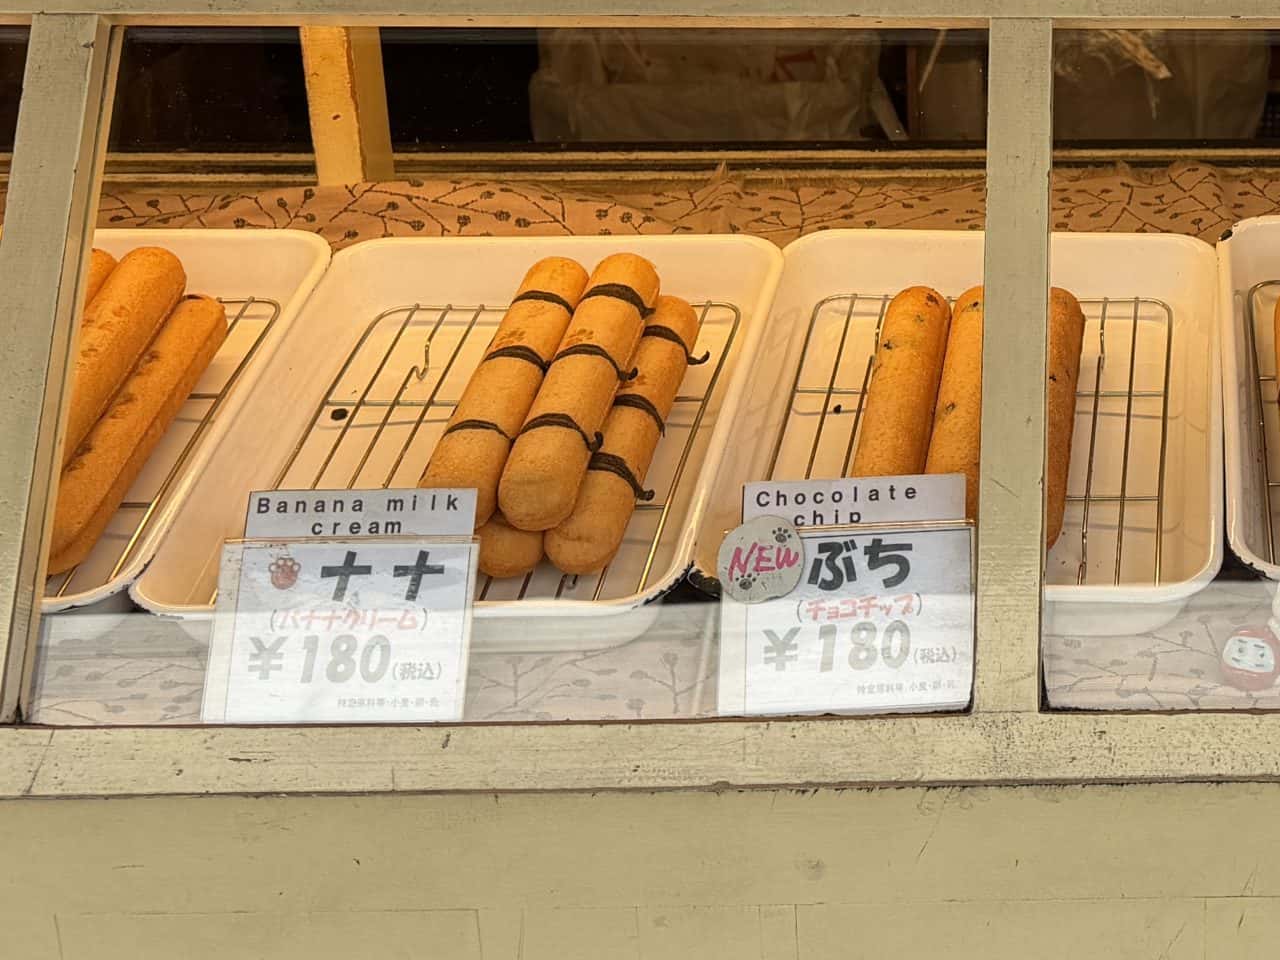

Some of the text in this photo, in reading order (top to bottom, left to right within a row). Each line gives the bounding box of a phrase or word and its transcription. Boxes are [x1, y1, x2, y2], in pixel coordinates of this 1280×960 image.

[257, 494, 458, 514] Banana milk
[756, 485, 917, 507] Chocolate
[311, 520, 402, 535] cream
[794, 510, 861, 526] chip
[727, 542, 800, 582] NEW
[807, 538, 913, 591] ぶち
[320, 550, 445, 602] ナナ
